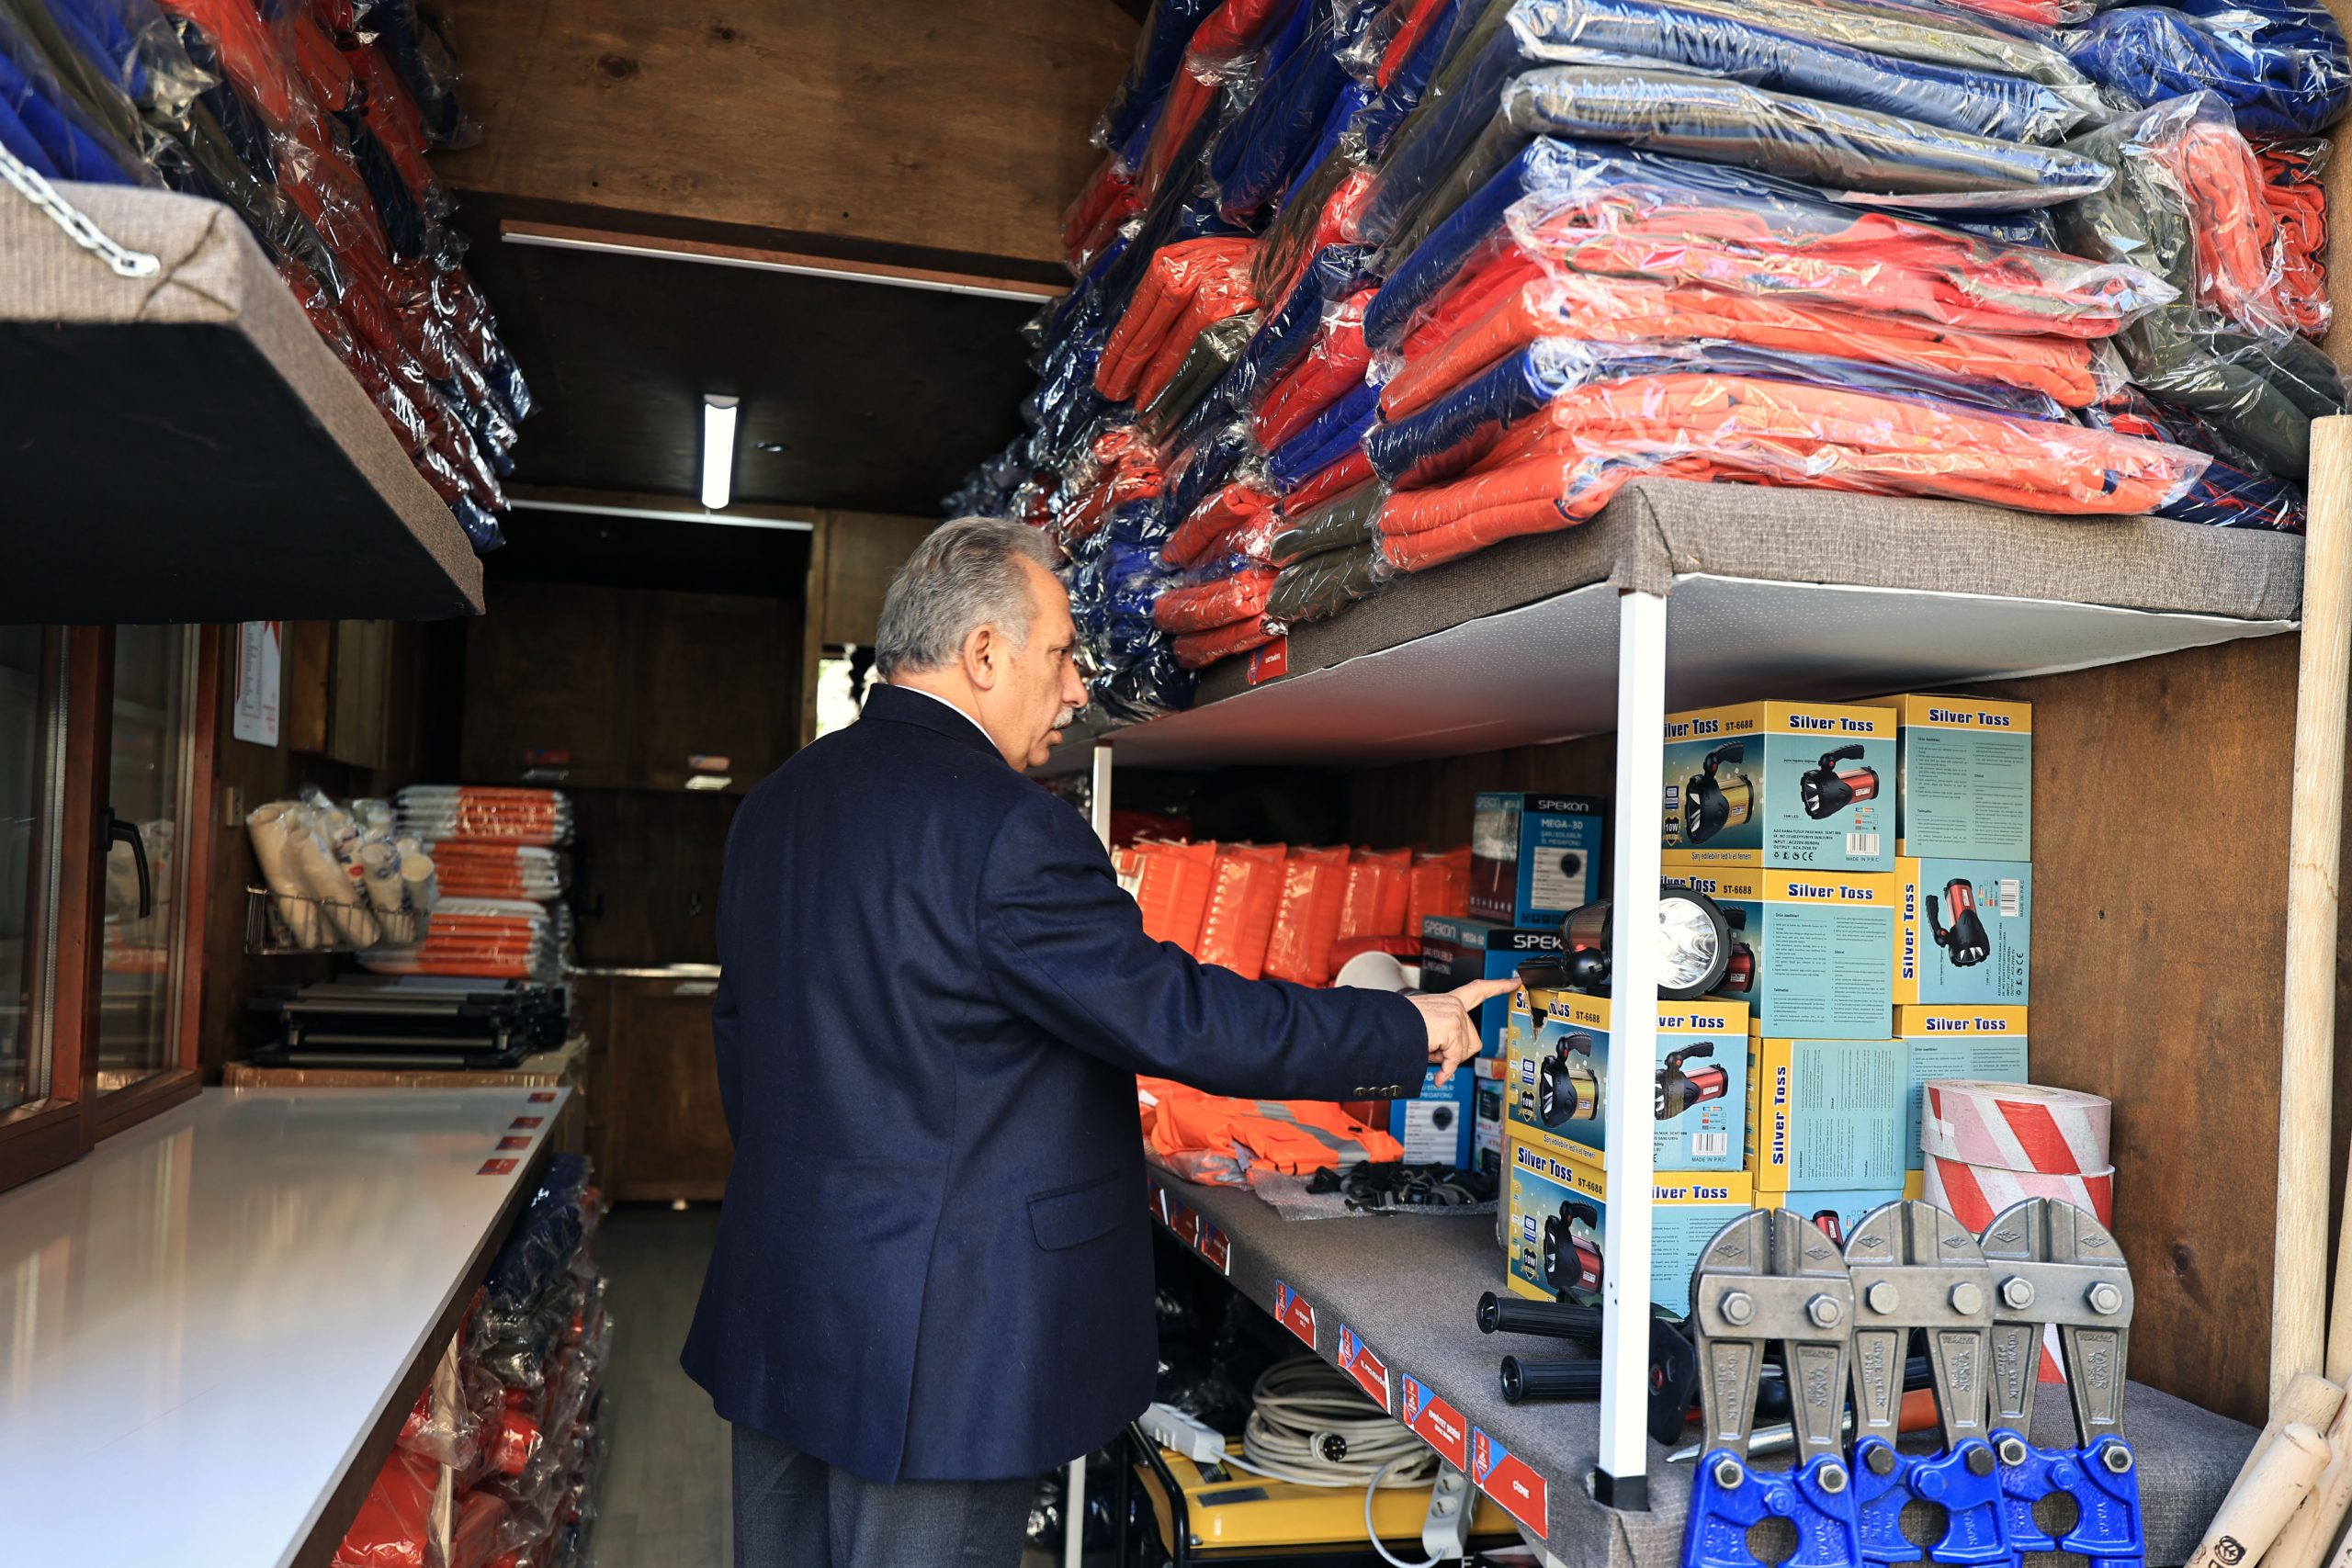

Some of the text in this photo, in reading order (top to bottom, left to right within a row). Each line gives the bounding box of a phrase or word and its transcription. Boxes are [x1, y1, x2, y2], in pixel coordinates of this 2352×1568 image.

[1790, 715, 1874, 732] Silver Toss
[1929, 709, 2010, 727] Silver Toss
[1664, 719, 1753, 738] ilver Toss ST-6688
[1537, 800, 1589, 812] SPEKON
[1541, 818, 1583, 829] MEGA-30
[1666, 823, 1678, 832] 10W
[1690, 875, 1716, 893] Toss
[1723, 885, 1752, 895] ST-6688
[1788, 884, 1873, 900] Silver Toss
[1902, 884, 1915, 979] Silver Toss
[1513, 933, 1564, 951] SPEK
[1576, 1010, 1600, 1023] ST-6688
[1658, 1015, 1724, 1028] ver Toss
[1926, 1018, 2006, 1031] Silver Toss
[1522, 1097, 1533, 1108] 10W
[1772, 1066, 1786, 1165] Silver Toss
[1518, 1146, 1603, 1195] Silver Toss ST-6688
[1652, 1186, 1728, 1199] ilver Toss
[1958, 1351, 1971, 1393] YAKAR
[2095, 1348, 2108, 1390] YAKAR
[1815, 1366, 1828, 1408] YAKAR
